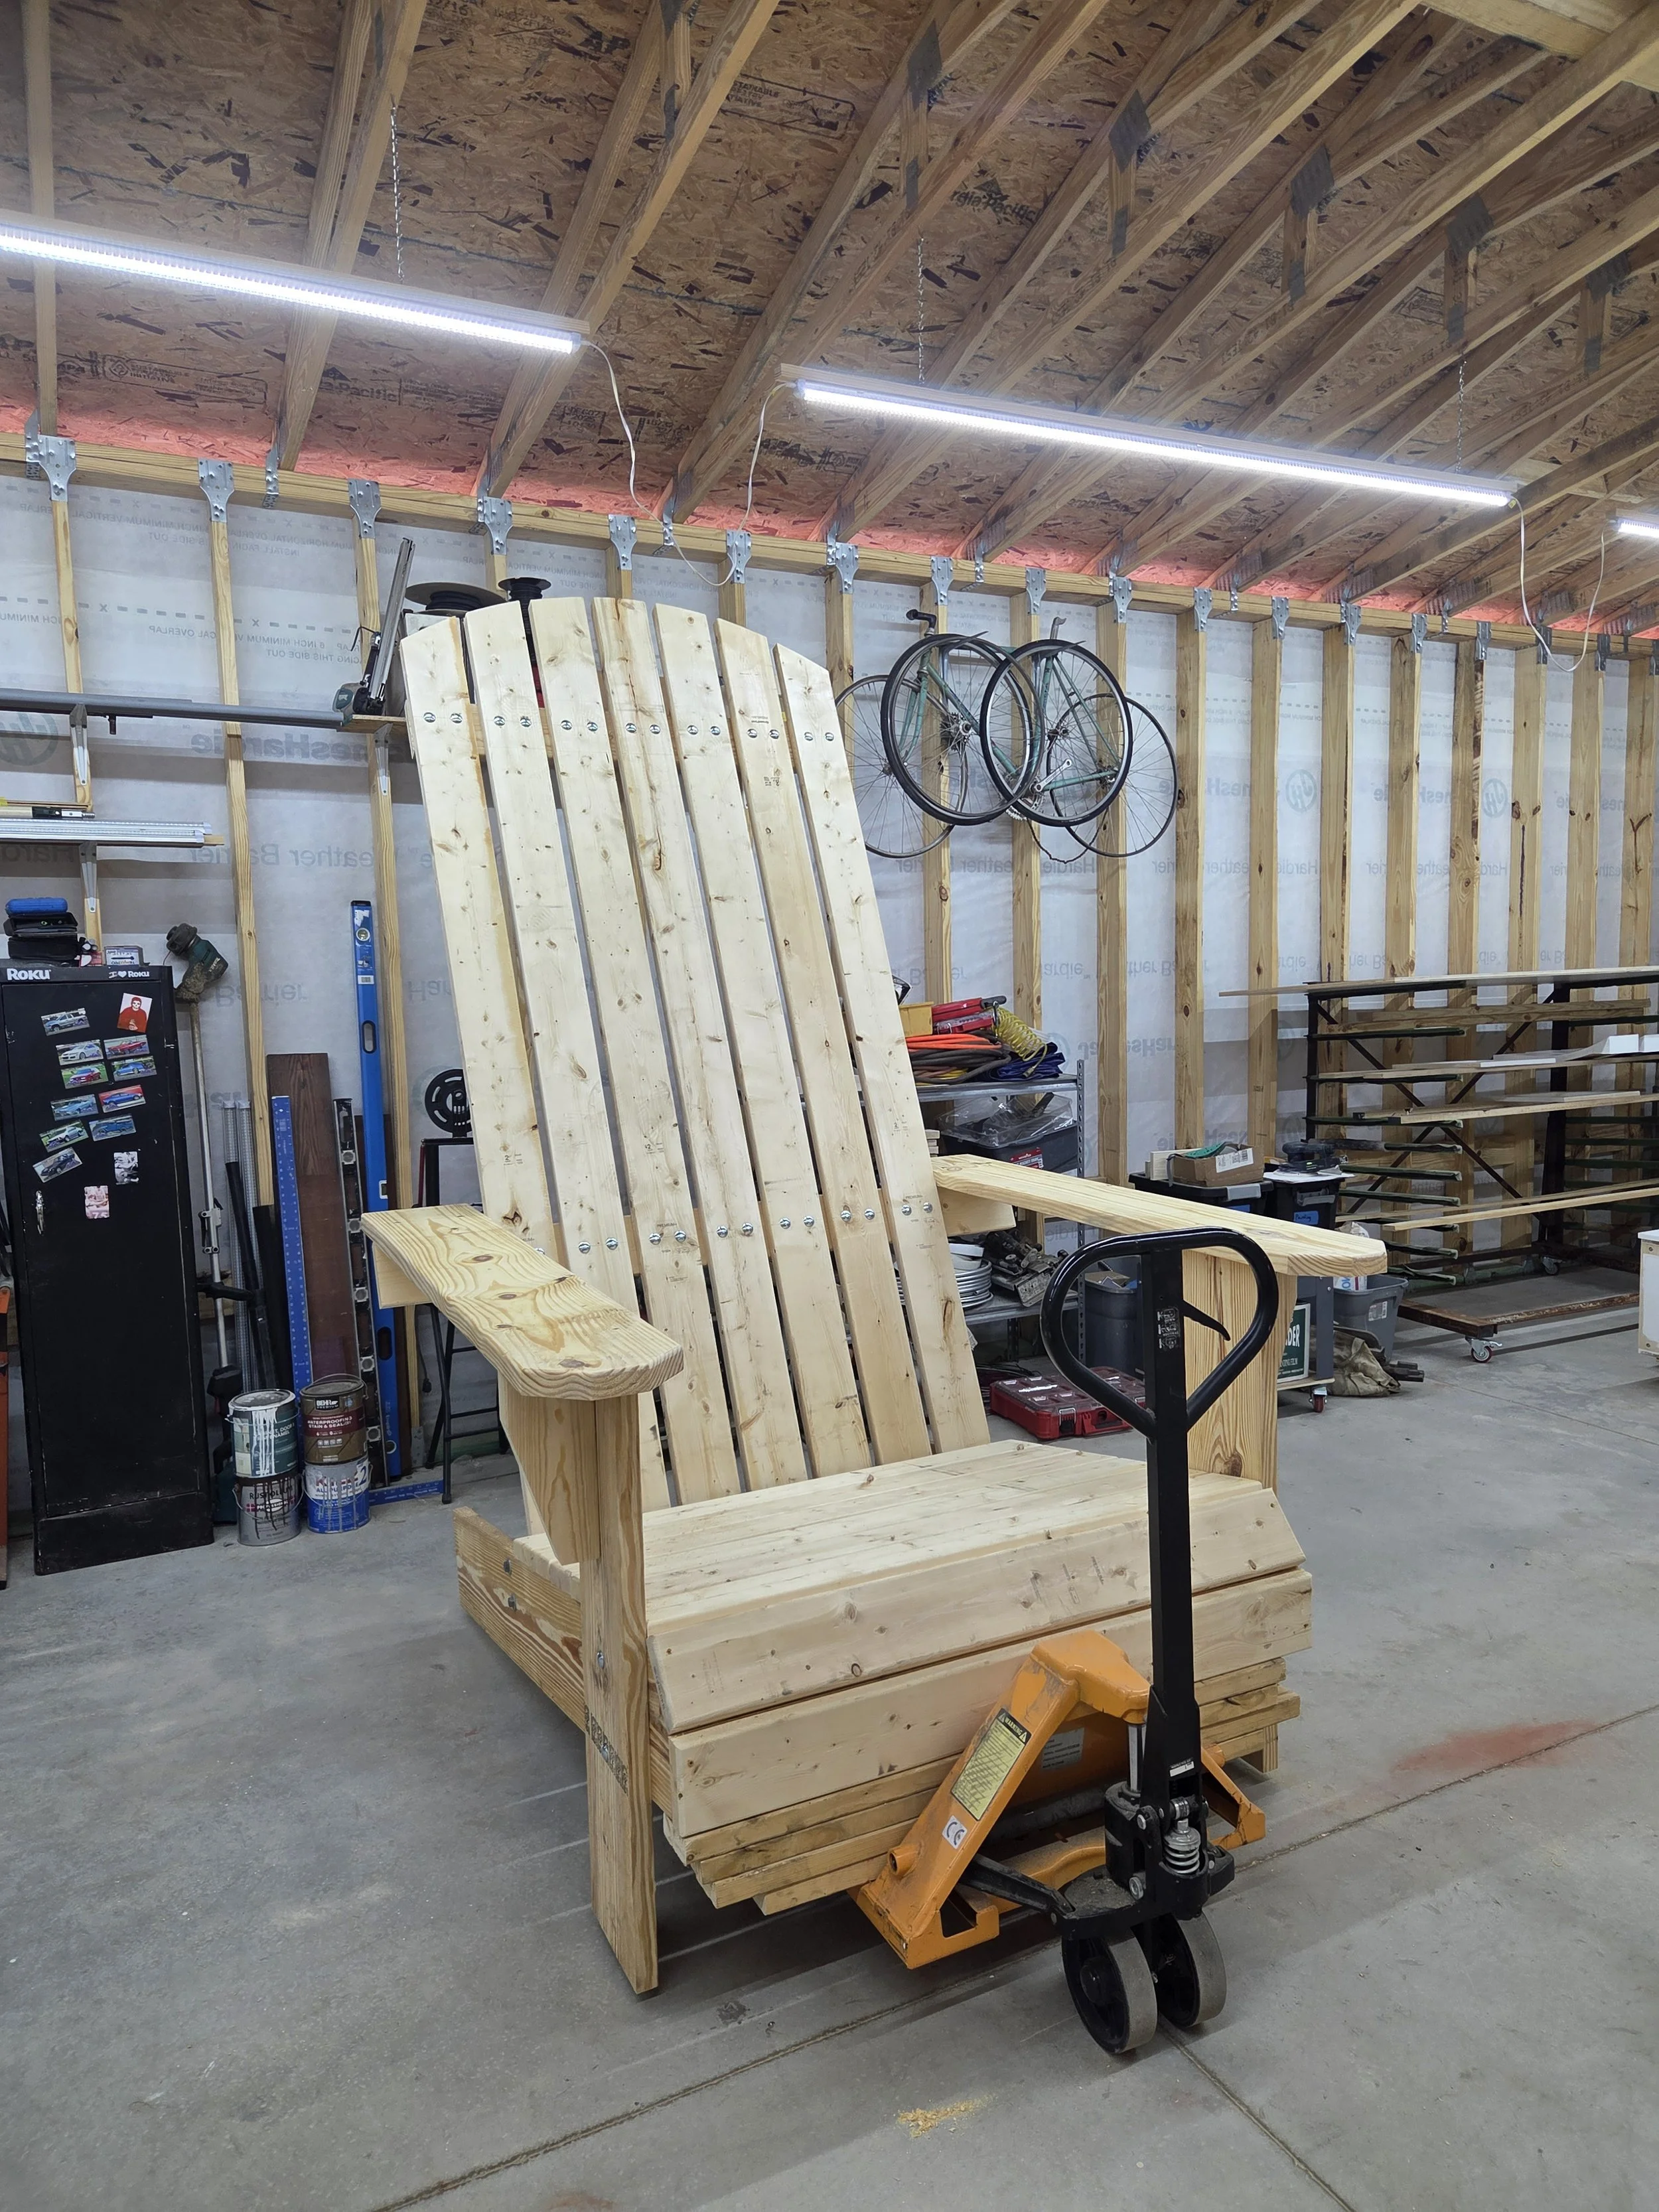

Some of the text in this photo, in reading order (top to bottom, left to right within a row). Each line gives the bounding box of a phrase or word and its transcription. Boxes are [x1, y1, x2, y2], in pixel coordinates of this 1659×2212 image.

[1285, 1323, 1300, 1348] DER
[1005, 1716, 1023, 1736] WARNING
[946, 1820, 967, 1846] CE
